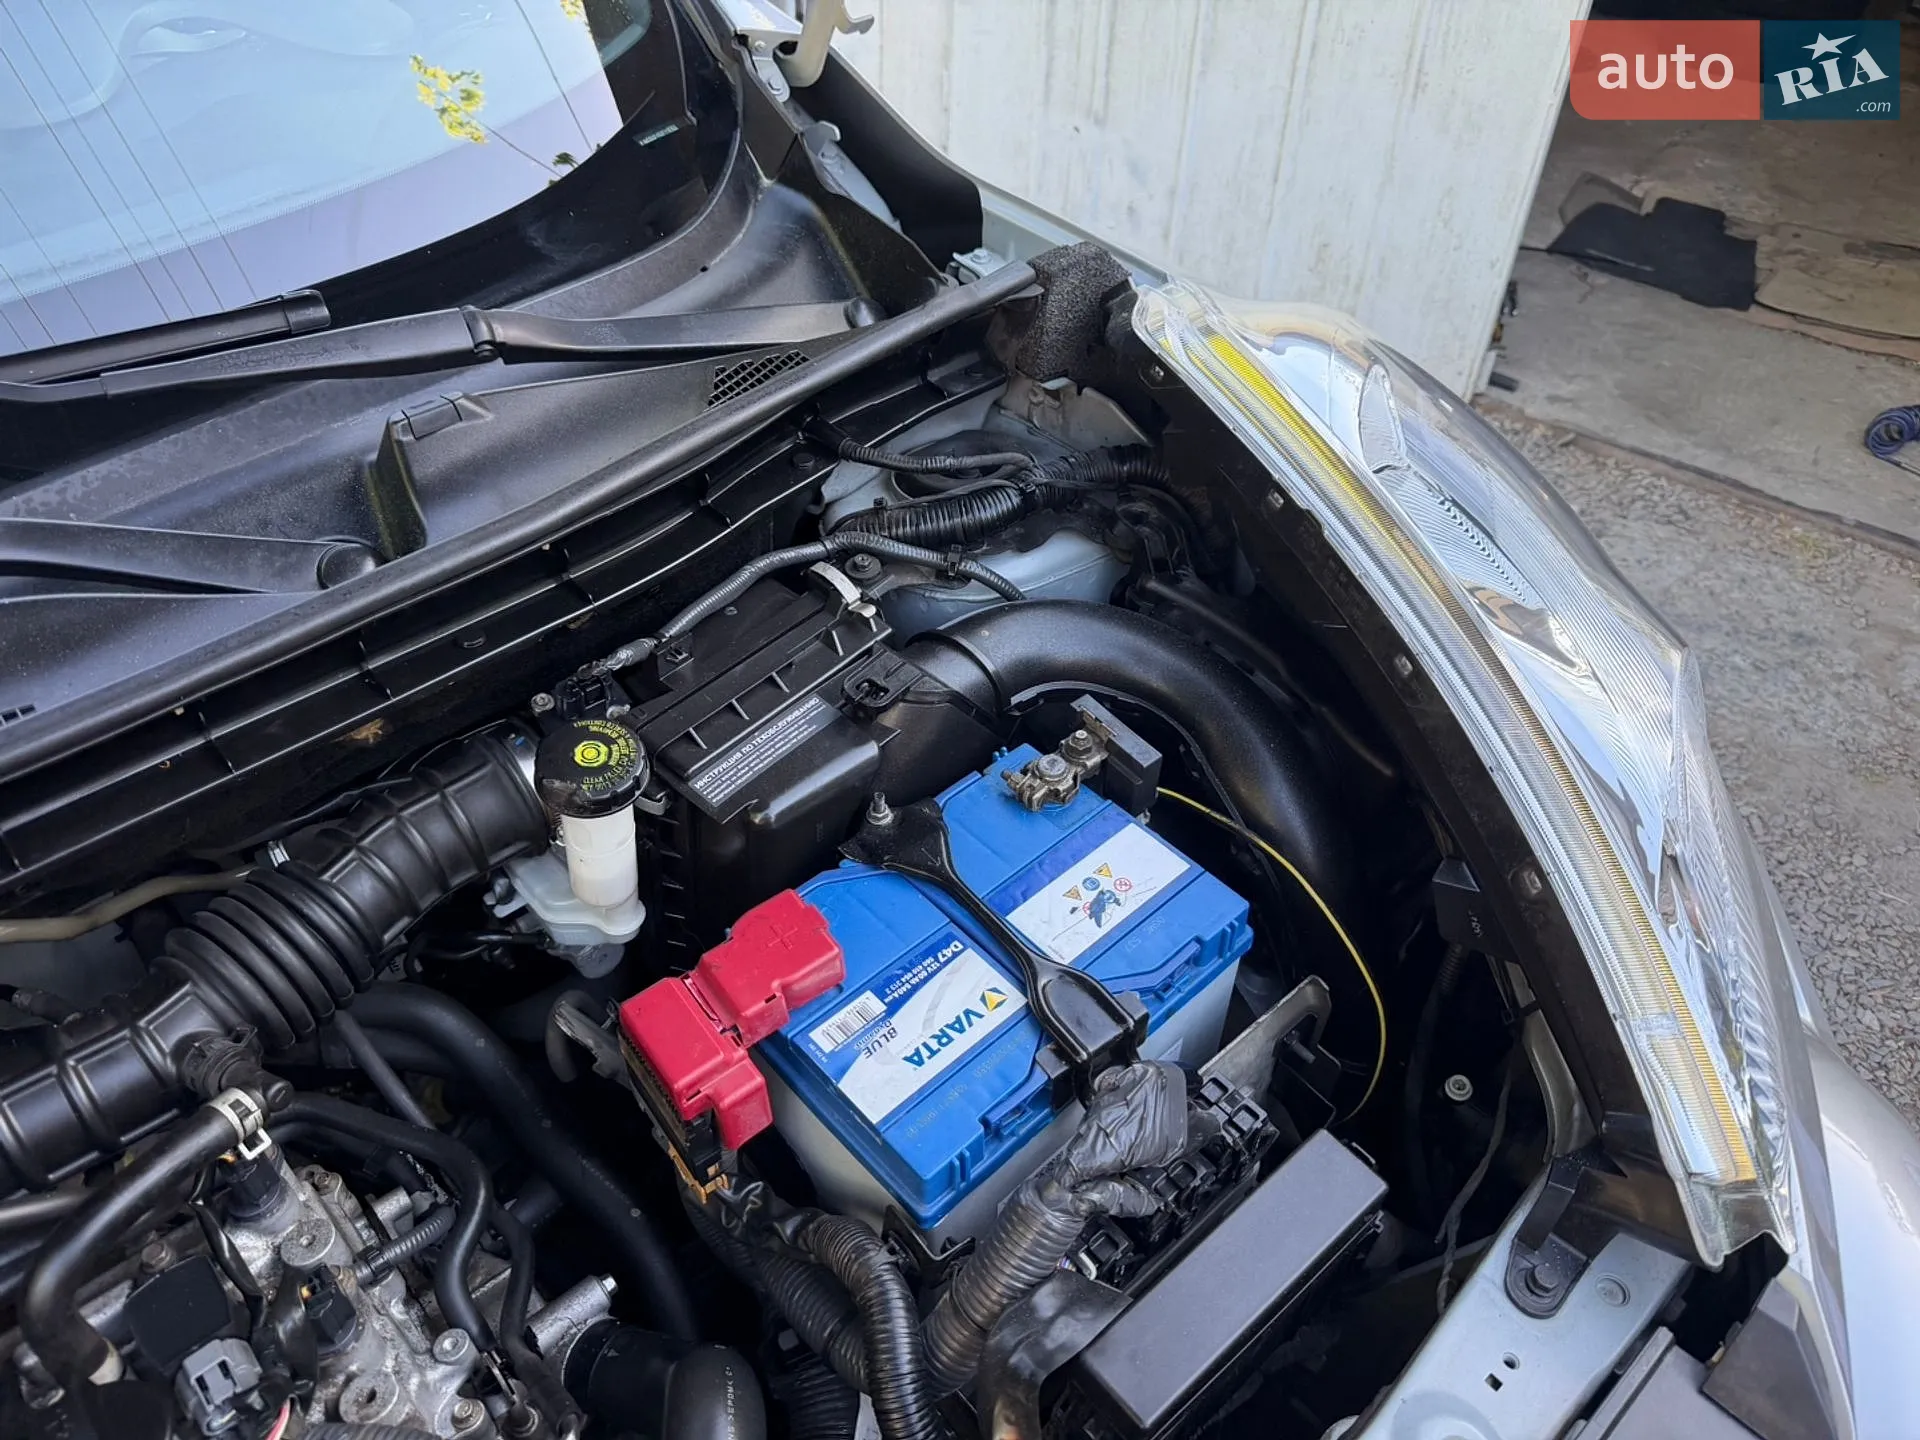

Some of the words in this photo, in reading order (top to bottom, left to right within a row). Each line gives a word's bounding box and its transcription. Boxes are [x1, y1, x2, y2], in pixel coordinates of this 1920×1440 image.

[694, 751, 743, 789] ИНСТРУКЦИЯ
[742, 743, 754, 755] ПО
[926, 961, 940, 974] 12V
[937, 940, 964, 963] D47
[862, 1027, 898, 1059] BLUE
[902, 1008, 985, 1067] VARTA
